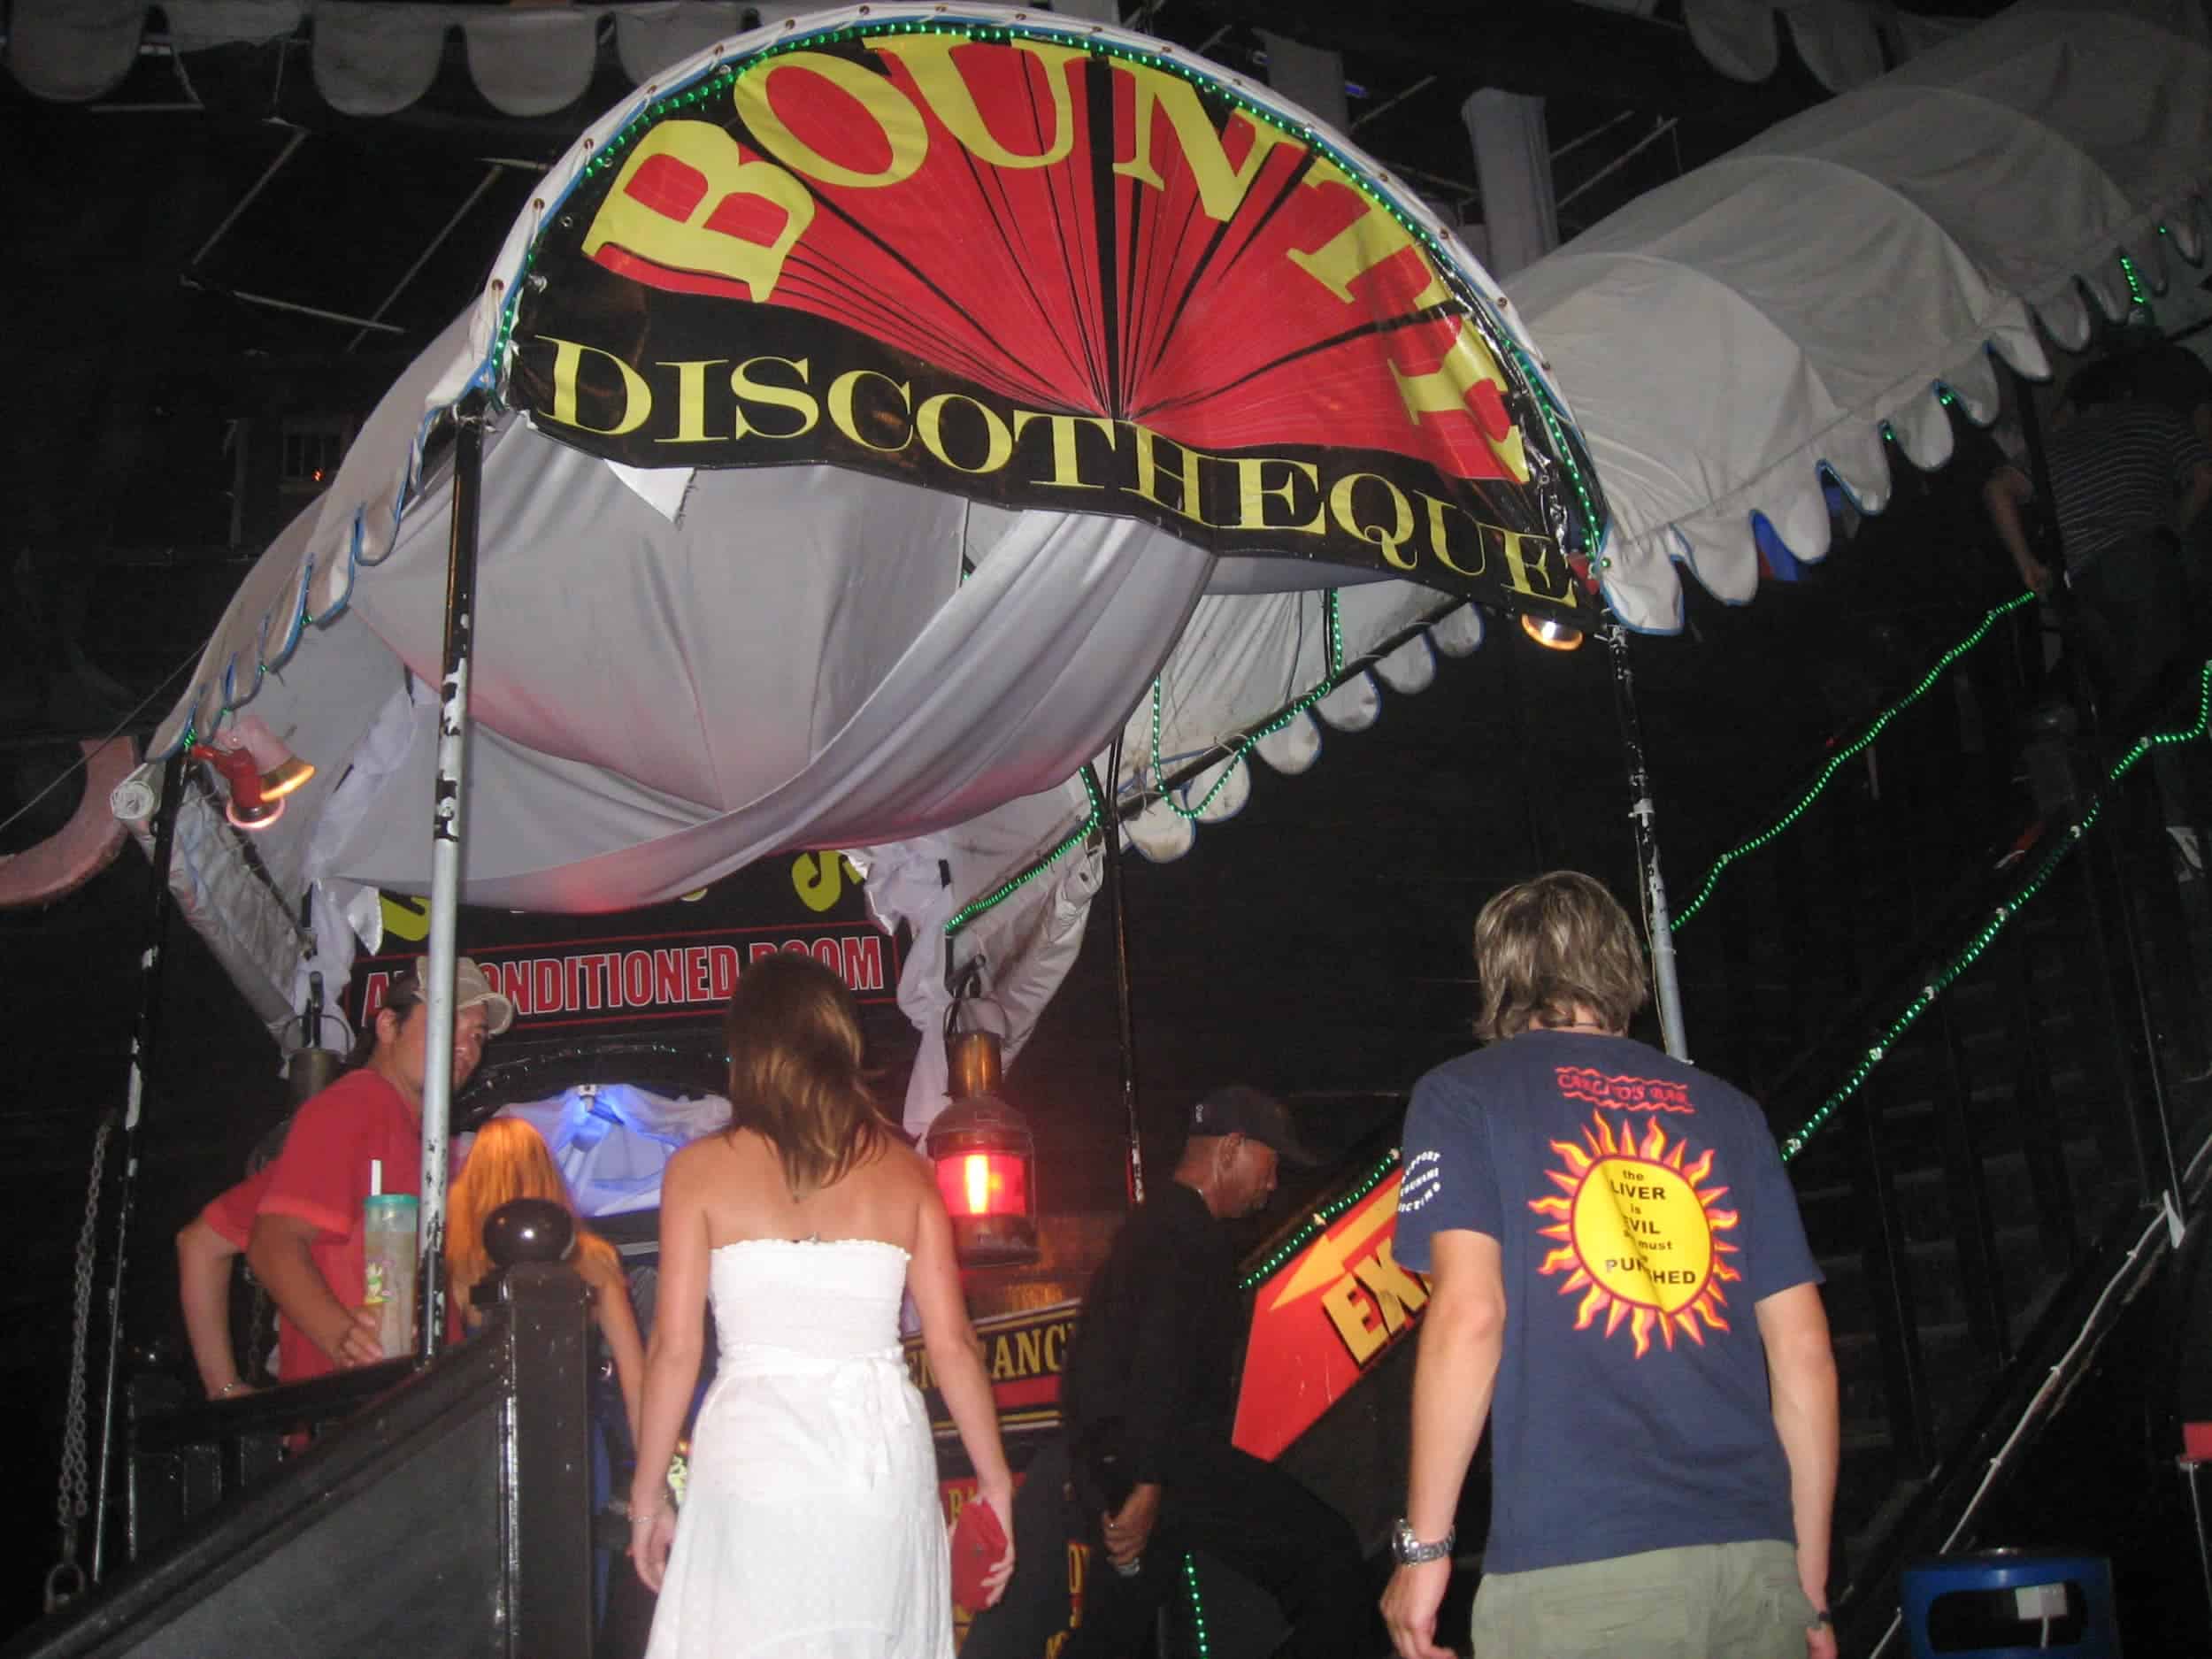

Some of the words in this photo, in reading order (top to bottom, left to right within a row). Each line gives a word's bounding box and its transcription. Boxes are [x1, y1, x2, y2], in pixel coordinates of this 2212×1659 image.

[581, 34, 1530, 483] BOUNTY
[534, 334, 1578, 609] DISCOTHEQUE
[480, 943, 740, 1016] ONDITIONED
[749, 935, 884, 990] OM
[1610, 1180, 1666, 1200] LIVER
[1623, 1170, 1644, 1181] the
[1631, 1203, 1641, 1215] is
[1638, 1240, 1672, 1250] must
[1606, 1257, 1696, 1284] PUNHED
[1321, 1236, 1433, 1368] EX
[906, 1324, 1076, 1388] ENANC
